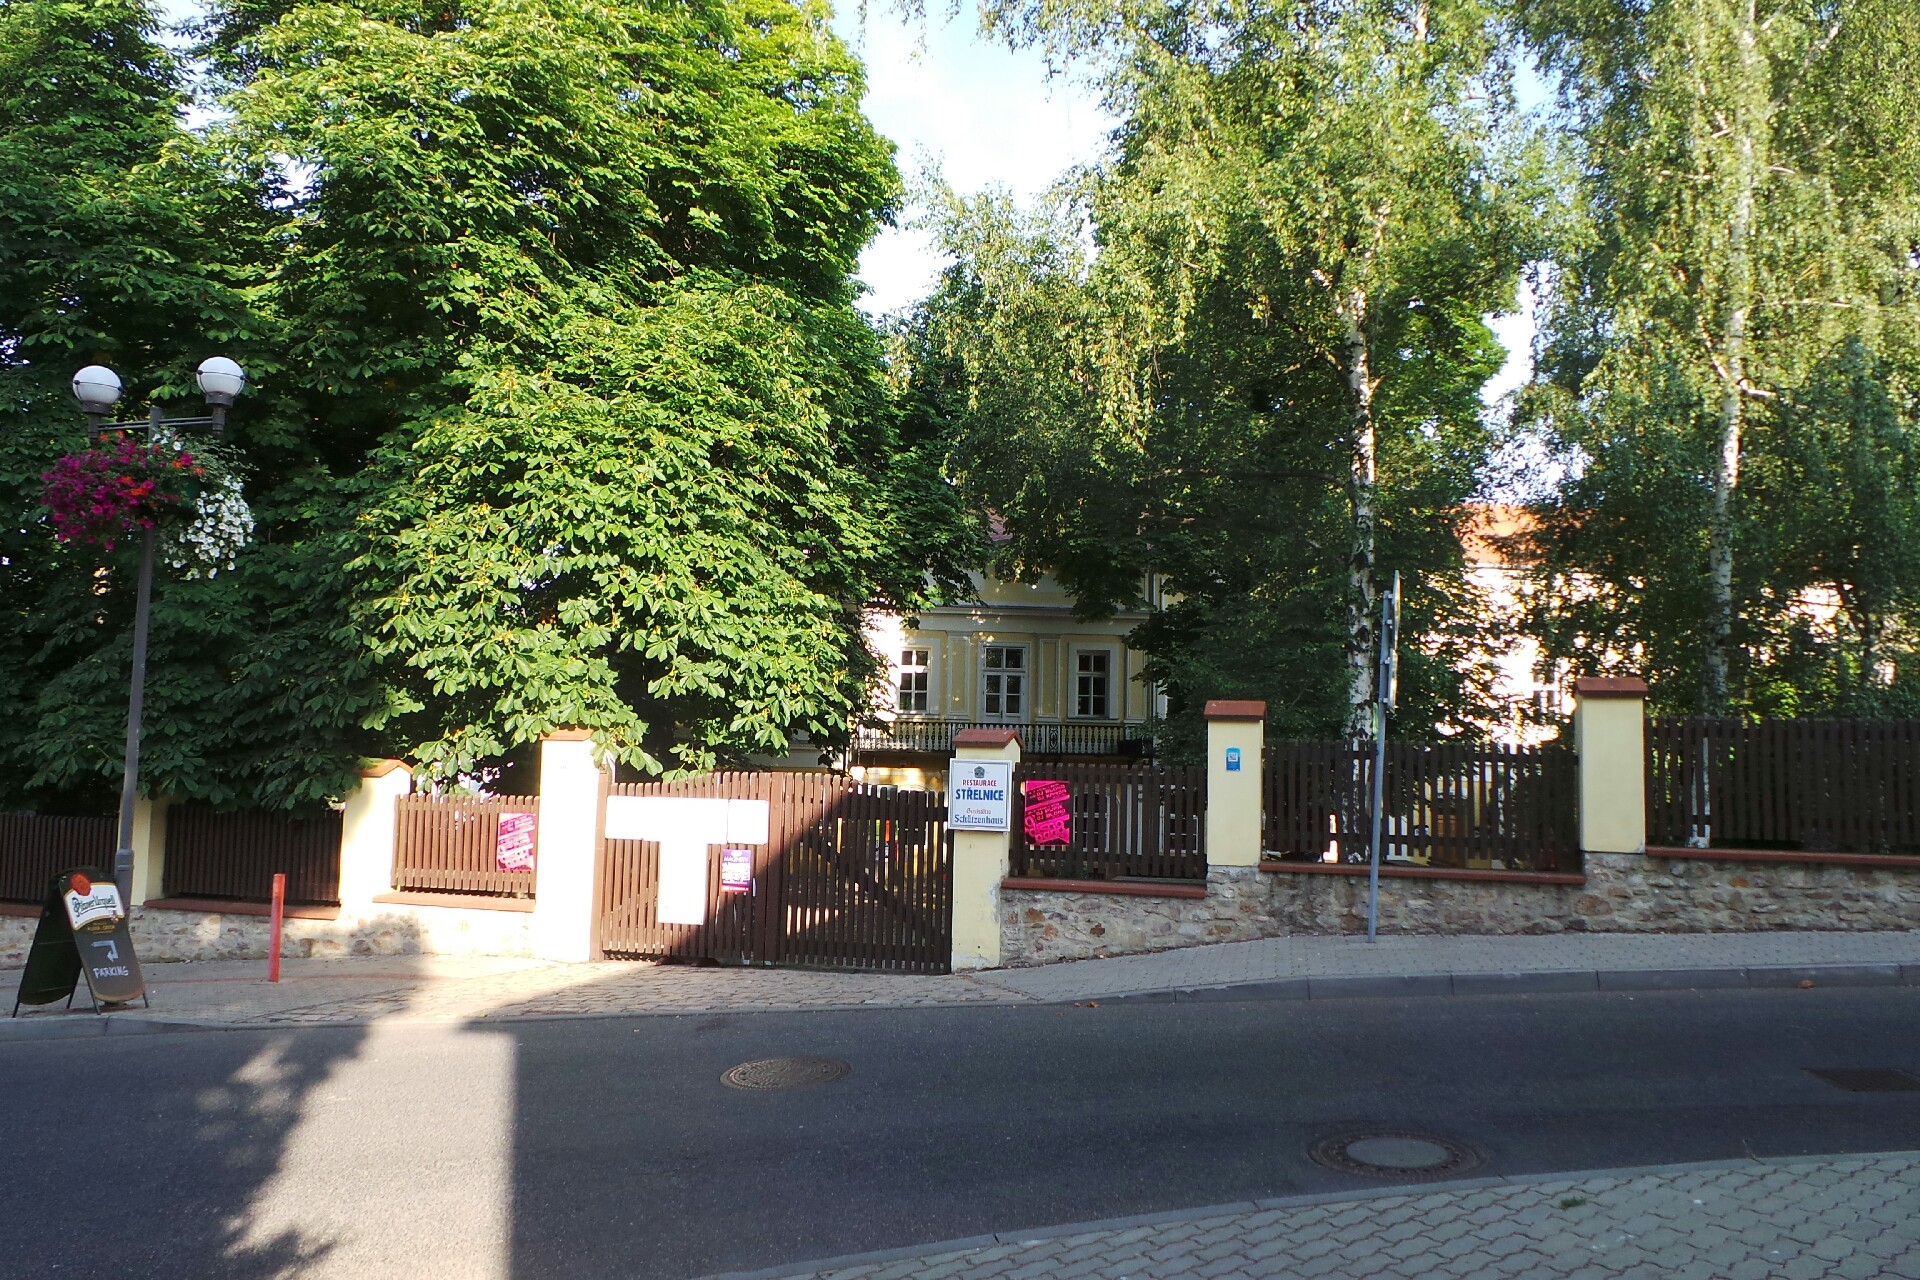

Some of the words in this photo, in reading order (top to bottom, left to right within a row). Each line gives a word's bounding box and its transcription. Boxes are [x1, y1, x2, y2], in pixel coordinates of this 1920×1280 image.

[962, 779, 997, 787] RESTAURACE
[955, 787, 1004, 801] STŘELNICE
[954, 814, 1004, 825] Schützenhaus
[94, 895, 117, 909] Urquell
[93, 965, 129, 979] PARKING
